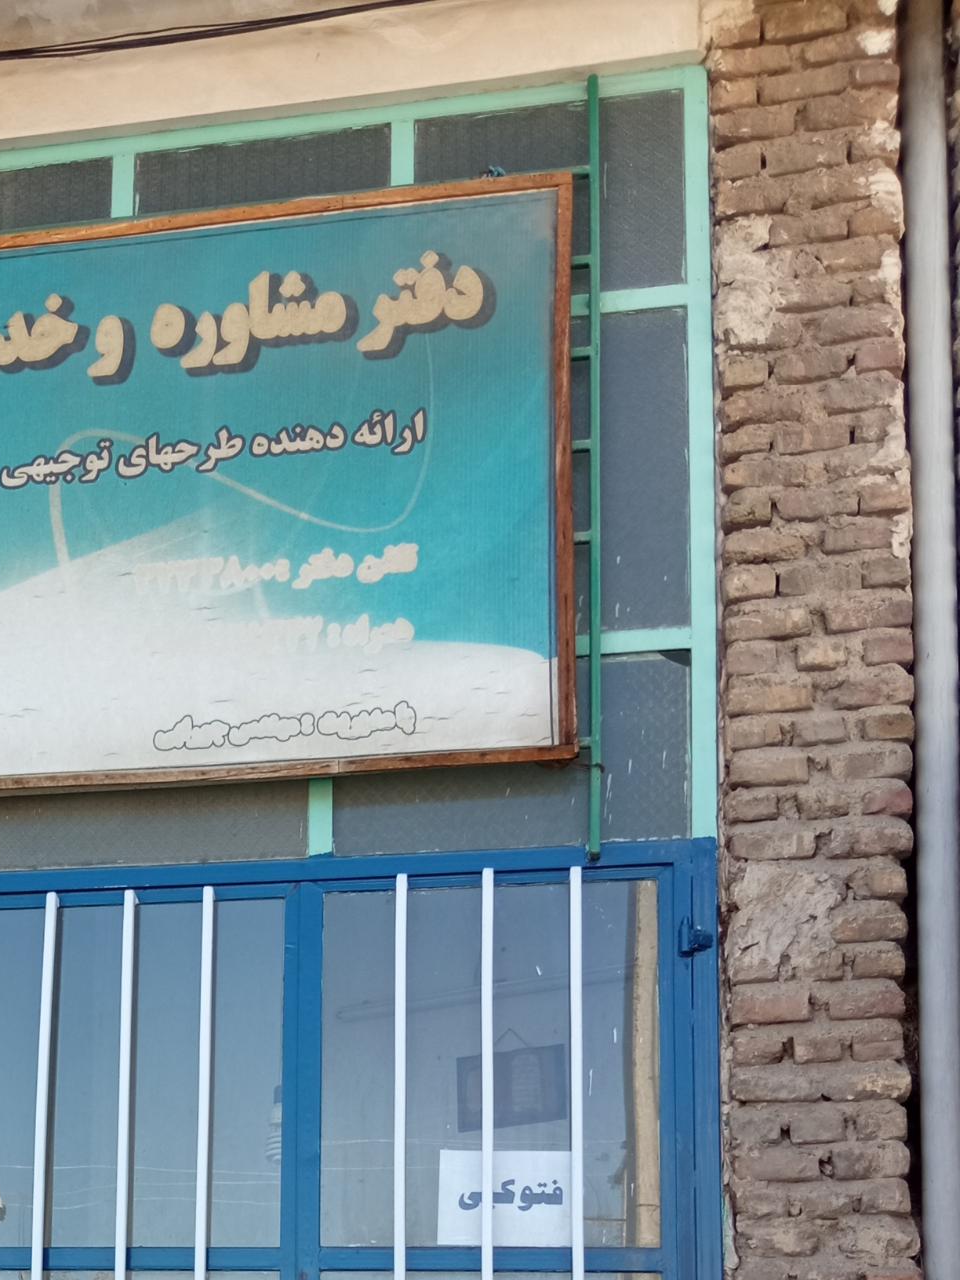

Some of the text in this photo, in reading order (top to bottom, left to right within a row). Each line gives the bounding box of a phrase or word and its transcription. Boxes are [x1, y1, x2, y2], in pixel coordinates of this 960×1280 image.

[150, 271, 347, 368] مشاوره
[356, 250, 484, 352] دفتر
[87, 315, 125, 377] و
[250, 422, 345, 459] دهنده
[353, 408, 427, 454] ارائه
[458, 1179, 563, 1212] فتوکی
